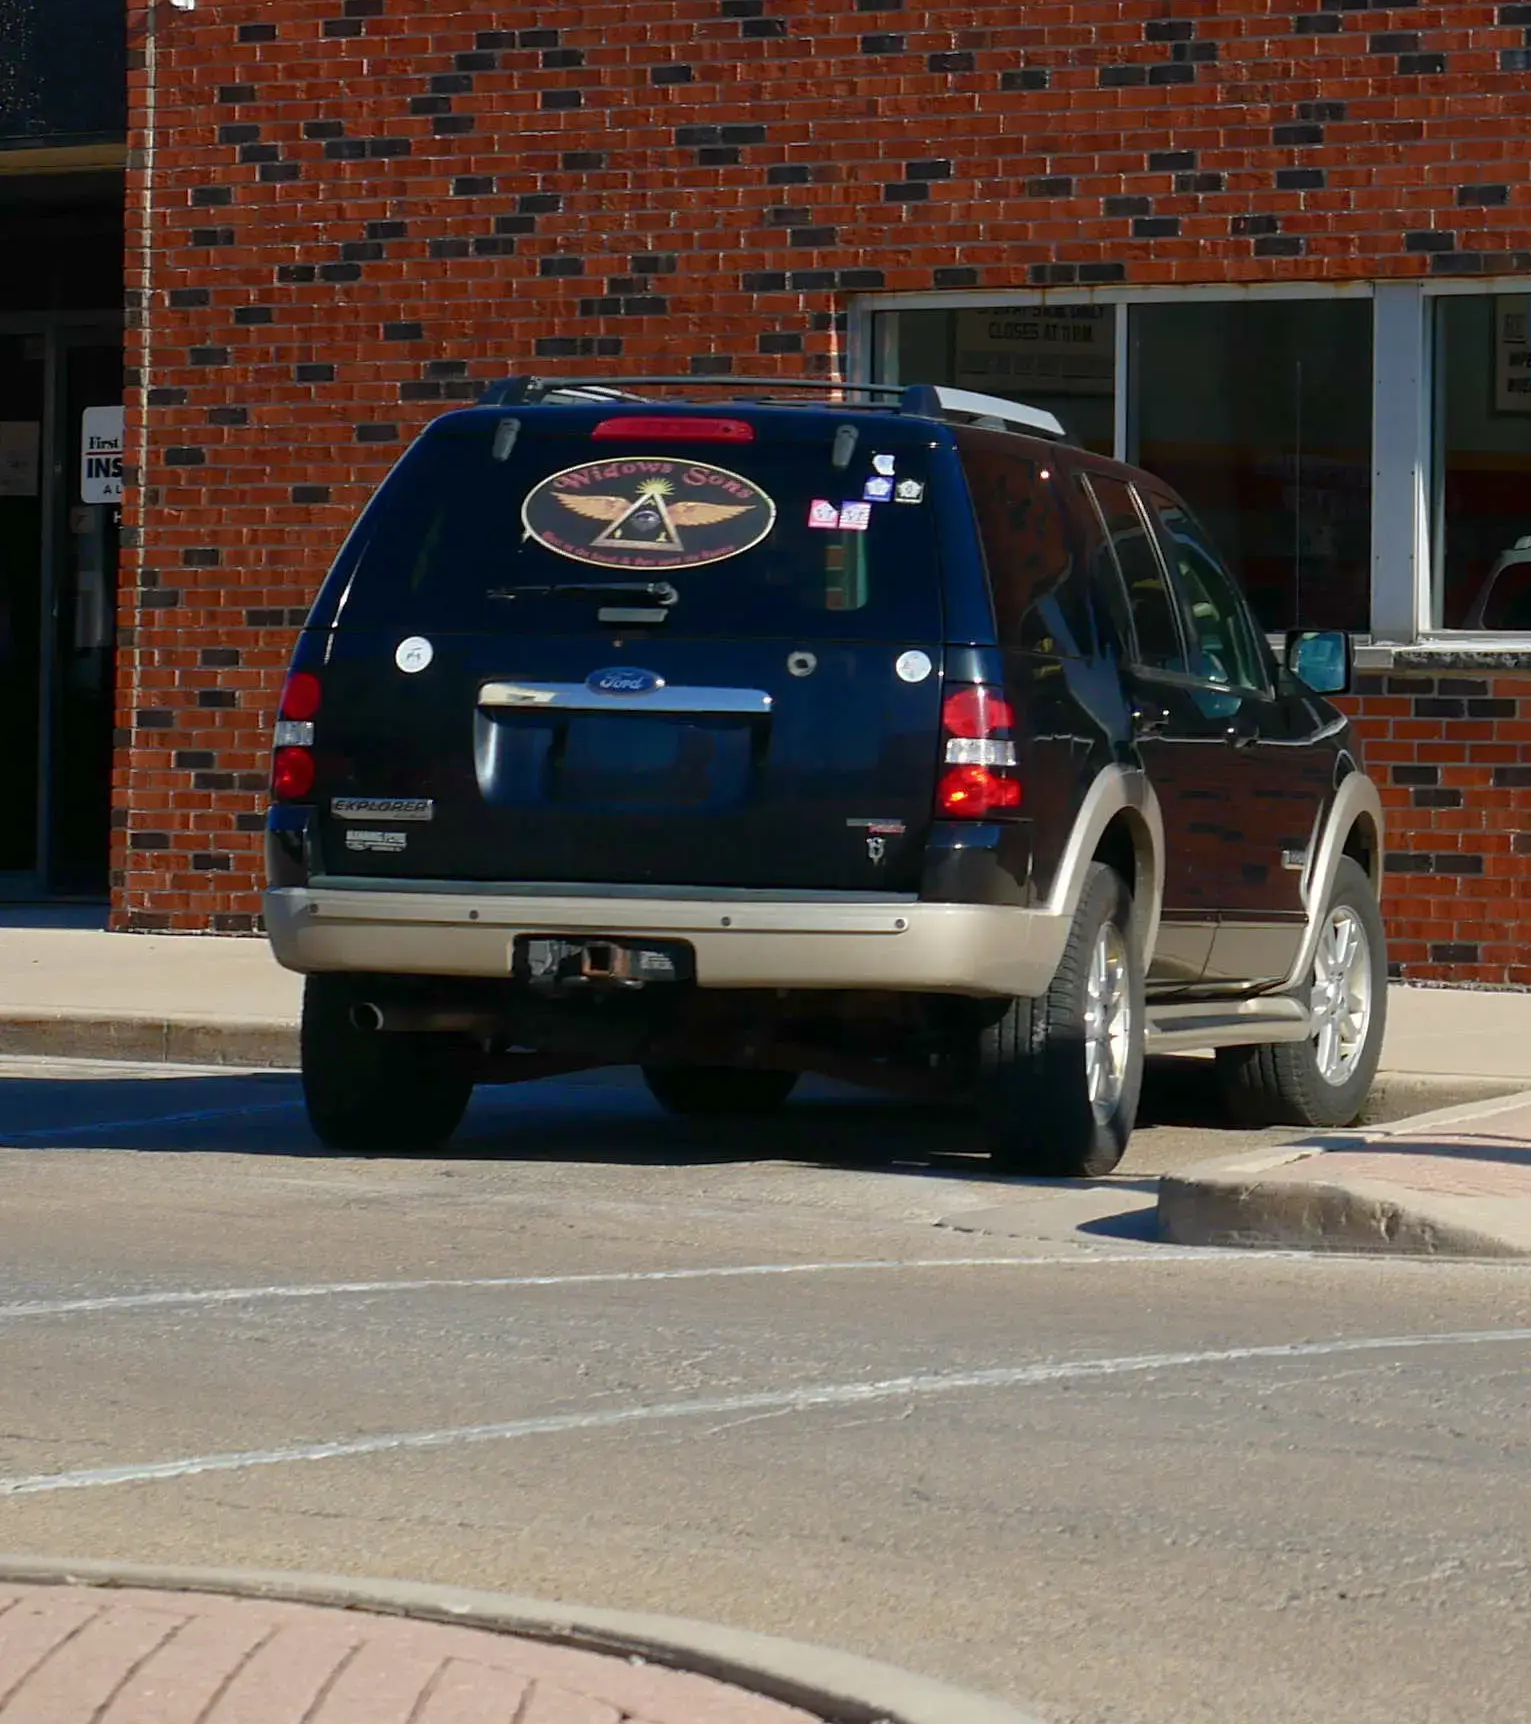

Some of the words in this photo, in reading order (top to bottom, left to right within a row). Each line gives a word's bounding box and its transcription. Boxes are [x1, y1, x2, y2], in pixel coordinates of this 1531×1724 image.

[89, 436, 119, 449] First
[553, 460, 674, 490] Widows
[682, 466, 755, 499] Sons
[599, 672, 645, 690] Ford
[334, 799, 428, 812] EXPLORER
